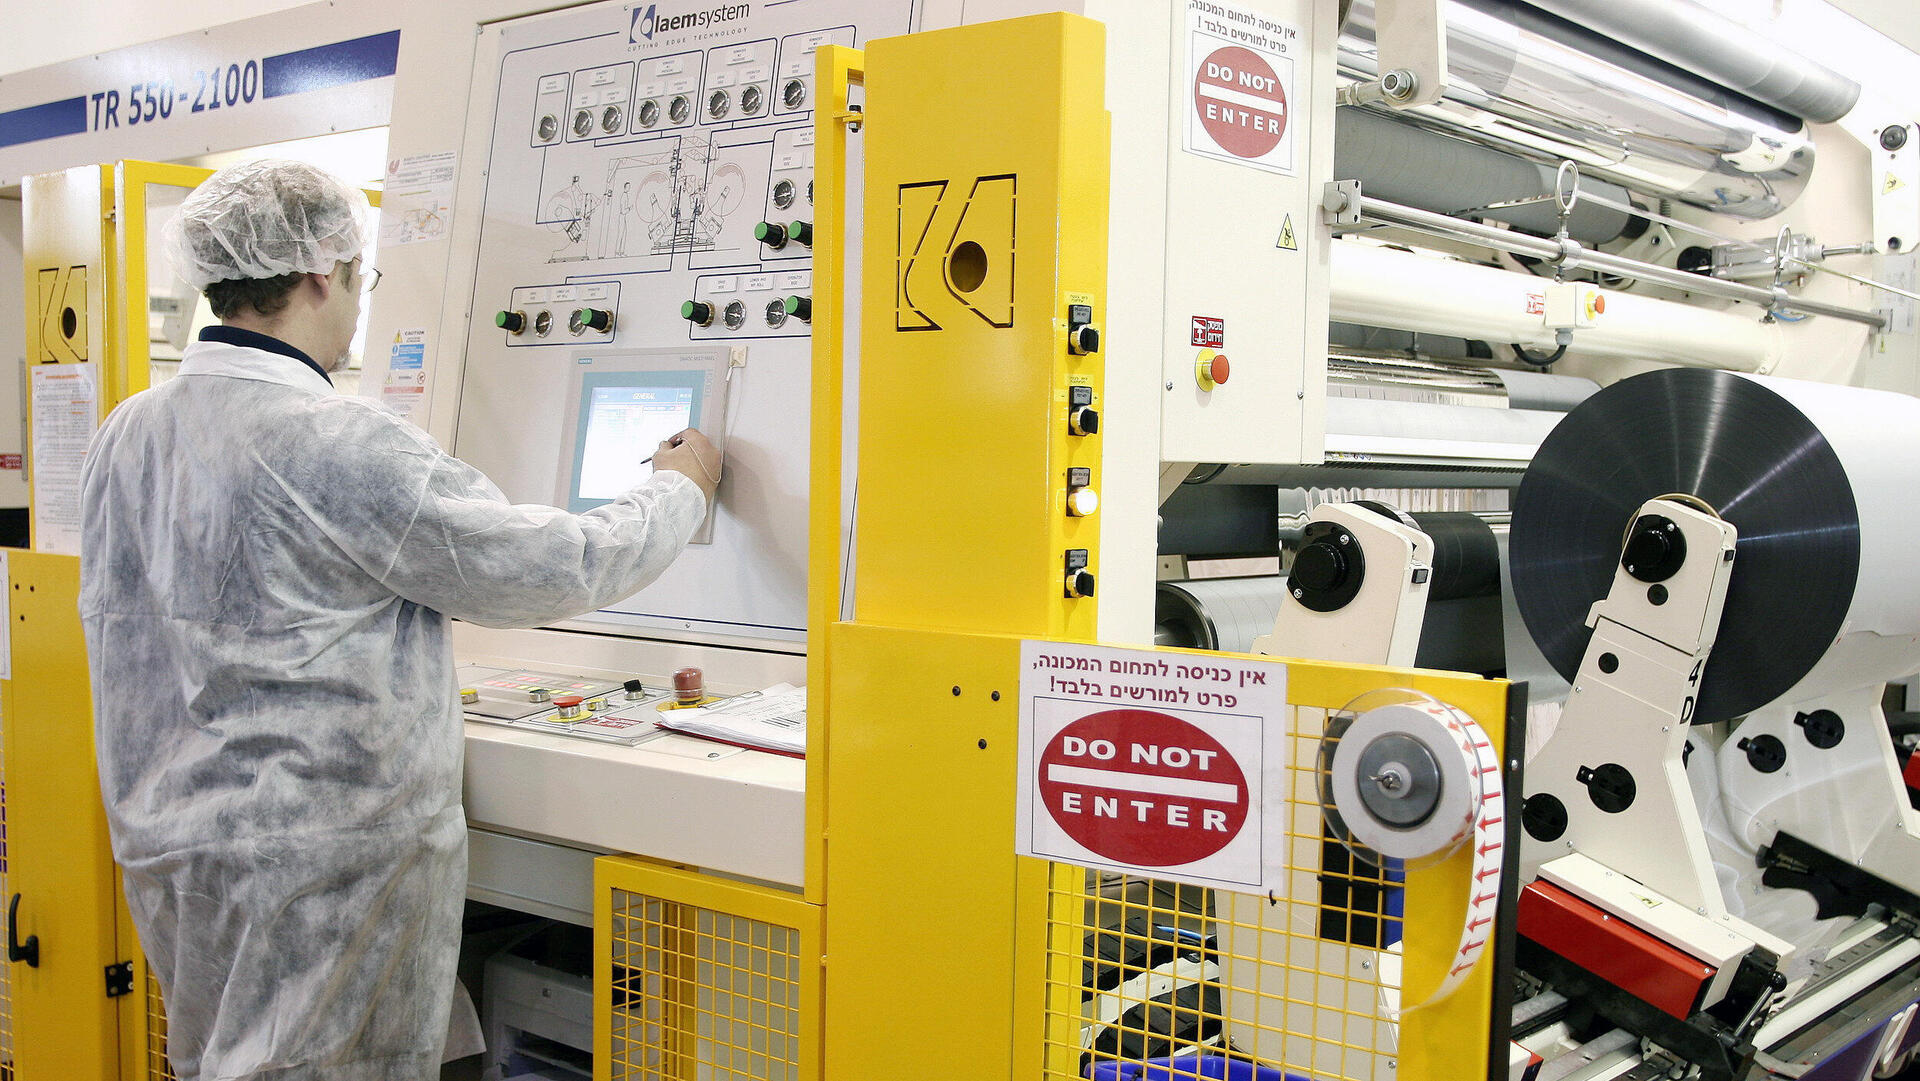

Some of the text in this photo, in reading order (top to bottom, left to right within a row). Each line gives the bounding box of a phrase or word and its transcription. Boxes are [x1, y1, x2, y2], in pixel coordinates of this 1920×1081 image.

[654, 3, 750, 33] laemsystem
[1227, 9, 1256, 26] לתחום
[1259, 19, 1282, 34] כניסה
[627, 27, 748, 52] CUTTING EDGE TECHNOLOGY
[1231, 28, 1267, 47] למורשים
[1269, 40, 1287, 52] פרט
[1284, 28, 1296, 39] אין
[1207, 62, 1275, 93] DO NOT
[91, 90, 120, 131] TR
[1206, 103, 1280, 135] ENTER
[1033, 654, 1266, 688] אין כניסה לתחום המכונה,
[1688, 659, 1703, 687] 4
[1050, 675, 1238, 708] פרט למורשים בלבד!
[1680, 696, 1694, 724] D
[1063, 735, 1218, 771] DO NOT
[1062, 791, 1228, 832] ENTER
